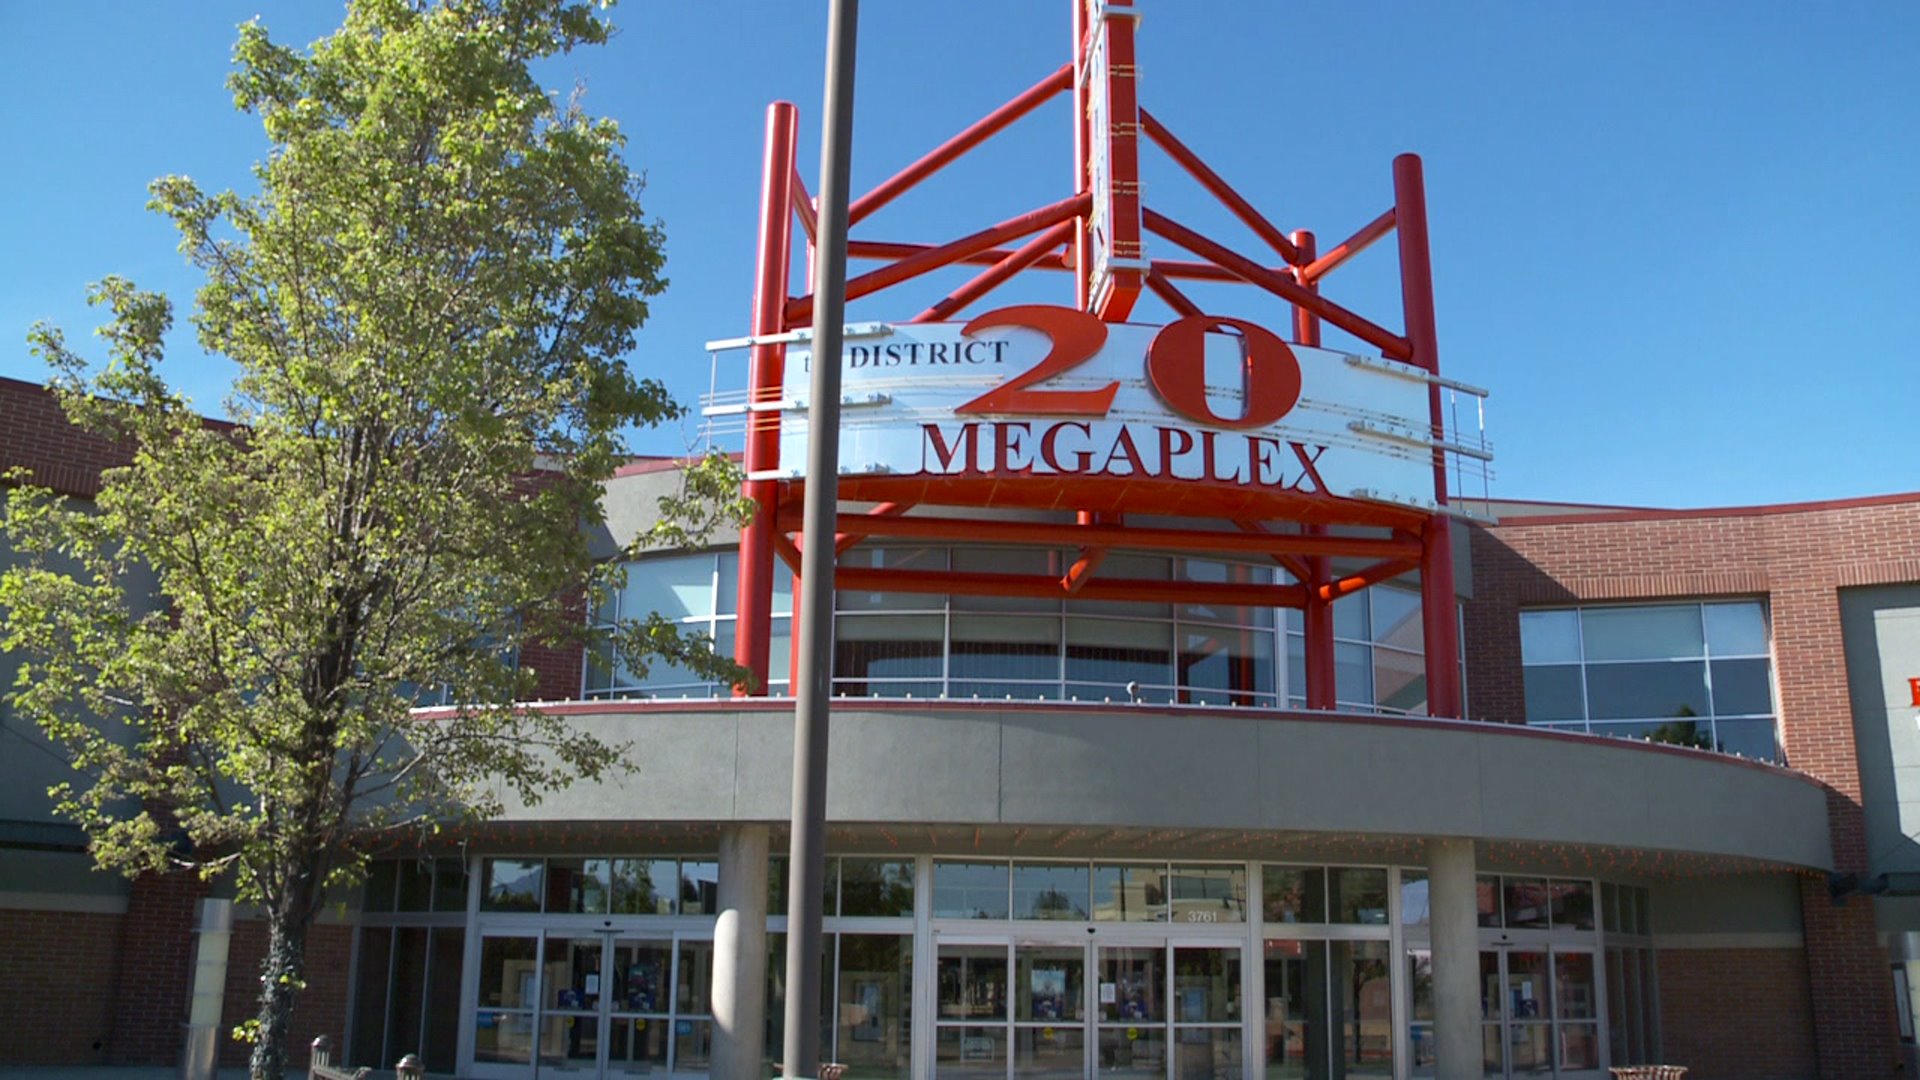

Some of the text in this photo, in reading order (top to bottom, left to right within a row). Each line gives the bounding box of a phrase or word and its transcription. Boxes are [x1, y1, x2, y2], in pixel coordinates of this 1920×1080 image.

[851, 341, 1009, 368] DISTRICT
[955, 304, 1302, 429] 20
[920, 421, 1333, 496] MEGAPLEX
[1188, 911, 1217, 922] 3761
